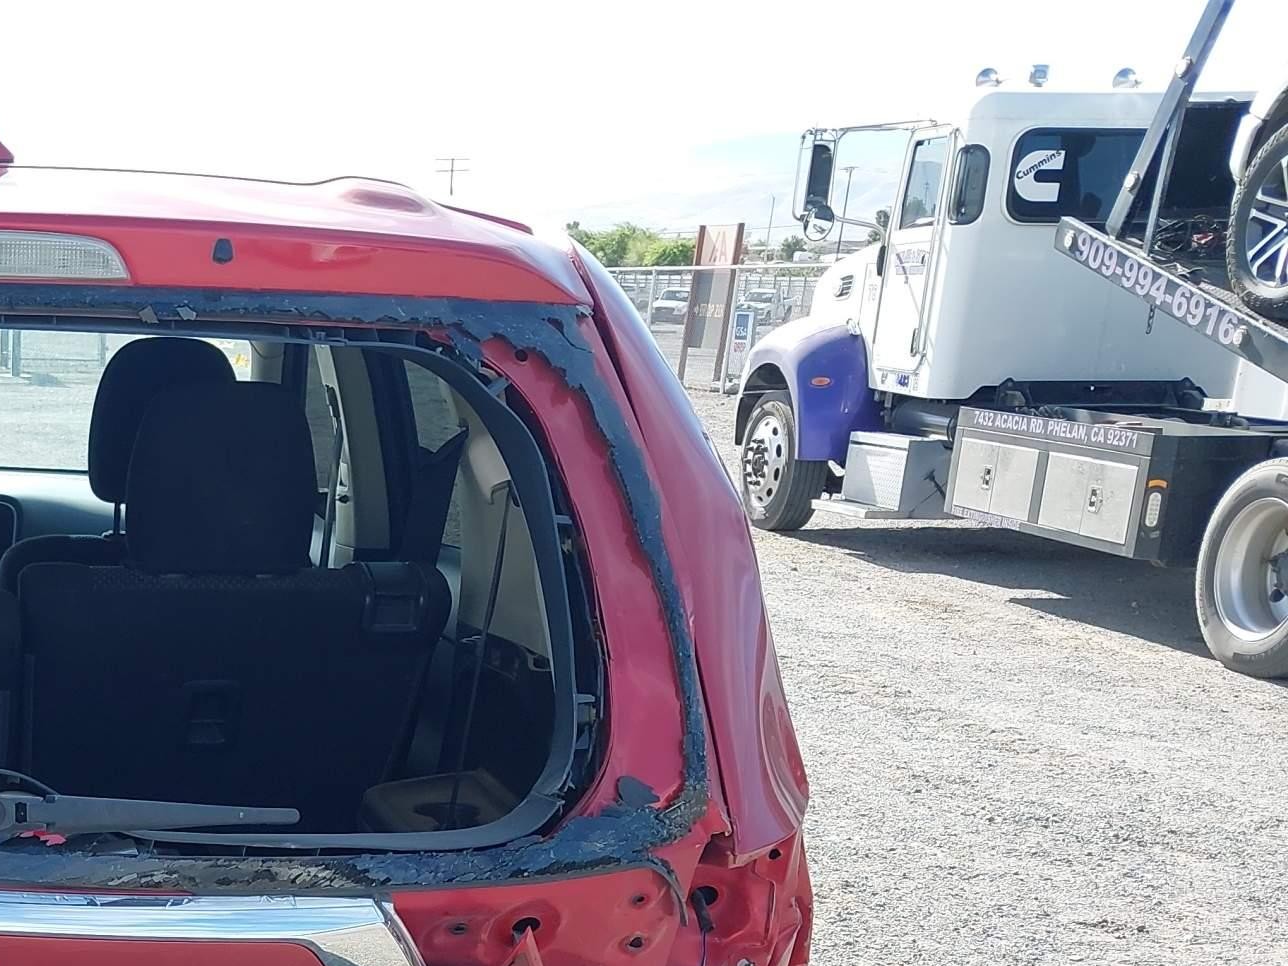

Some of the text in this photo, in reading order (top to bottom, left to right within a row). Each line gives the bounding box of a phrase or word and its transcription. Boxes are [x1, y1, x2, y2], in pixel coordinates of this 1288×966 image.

[1016, 150, 1062, 180] Cummins
[1075, 232, 1238, 345] 909-994-6916
[974, 411, 994, 427] 7432
[995, 414, 1028, 433] ACACIA
[1047, 421, 1088, 444] PHELAN,
[1091, 428, 1104, 443] CA
[1107, 431, 1138, 448] 92371
